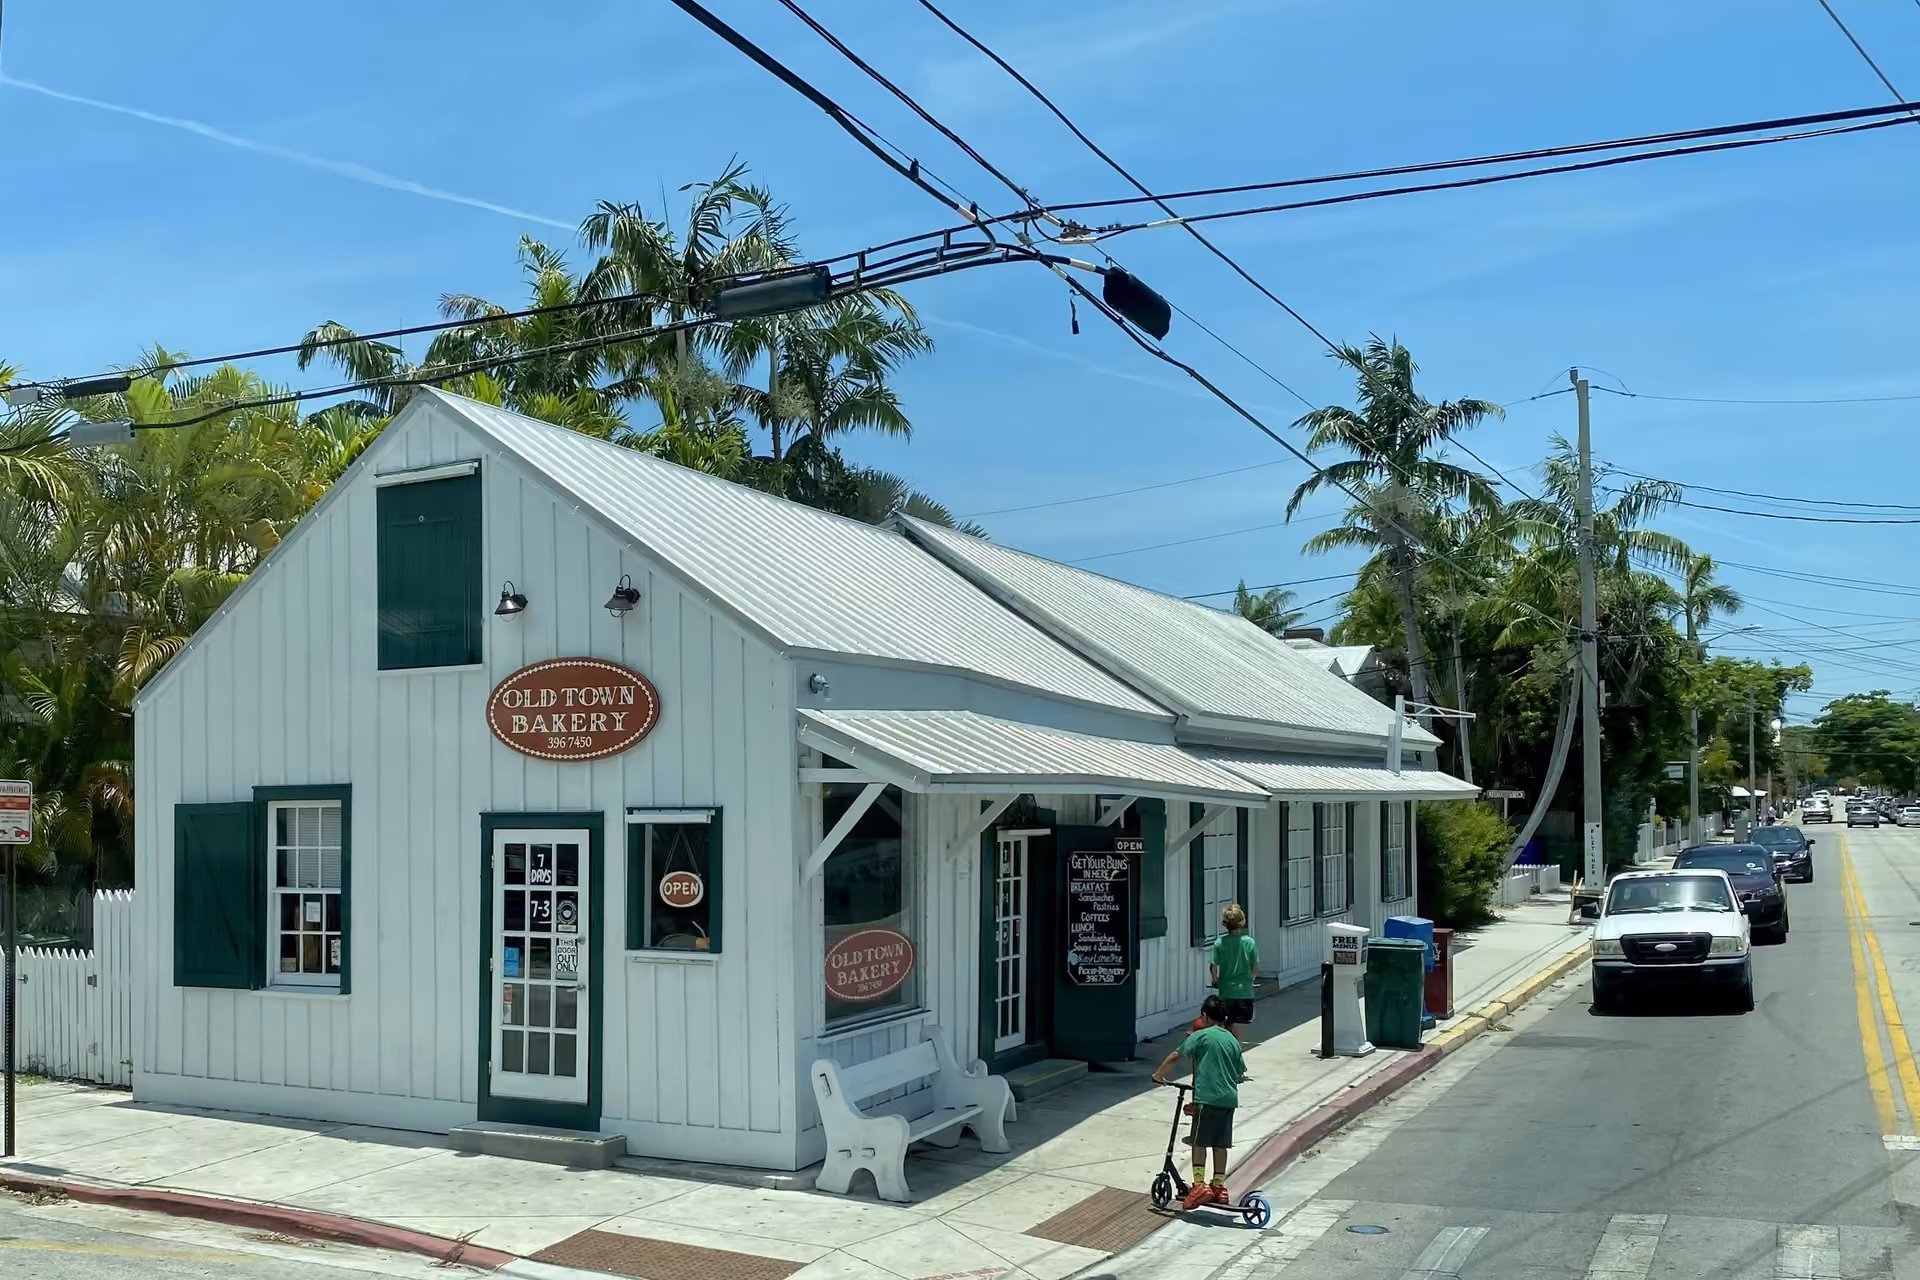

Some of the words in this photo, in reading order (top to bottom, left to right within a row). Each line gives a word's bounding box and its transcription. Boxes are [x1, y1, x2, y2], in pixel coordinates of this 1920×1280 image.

[502, 688, 558, 708] OLD
[560, 685, 636, 707] TOWN
[511, 712, 629, 734] BAKERY
[547, 737, 566, 749] 396
[567, 736, 592, 748] 7450
[1117, 841, 1143, 850] OPEN
[537, 853, 545, 868] 7
[1071, 854, 1086, 869] GET
[1085, 854, 1106, 869] YOUR
[1106, 855, 1128, 870] BUNS
[531, 869, 552, 883] DAYS
[1083, 870, 1091, 879] IN
[663, 882, 699, 895] OPEN
[530, 900, 550, 917] 7-3
[560, 939, 574, 947] THIS
[1332, 935, 1358, 944] FREE
[557, 946, 577, 954] DOOR
[830, 950, 863, 969] OLD
[864, 942, 904, 962] TOWN
[557, 954, 577, 963] OUT
[556, 962, 578, 972] ONLY
[836, 960, 901, 986] BAKERY
